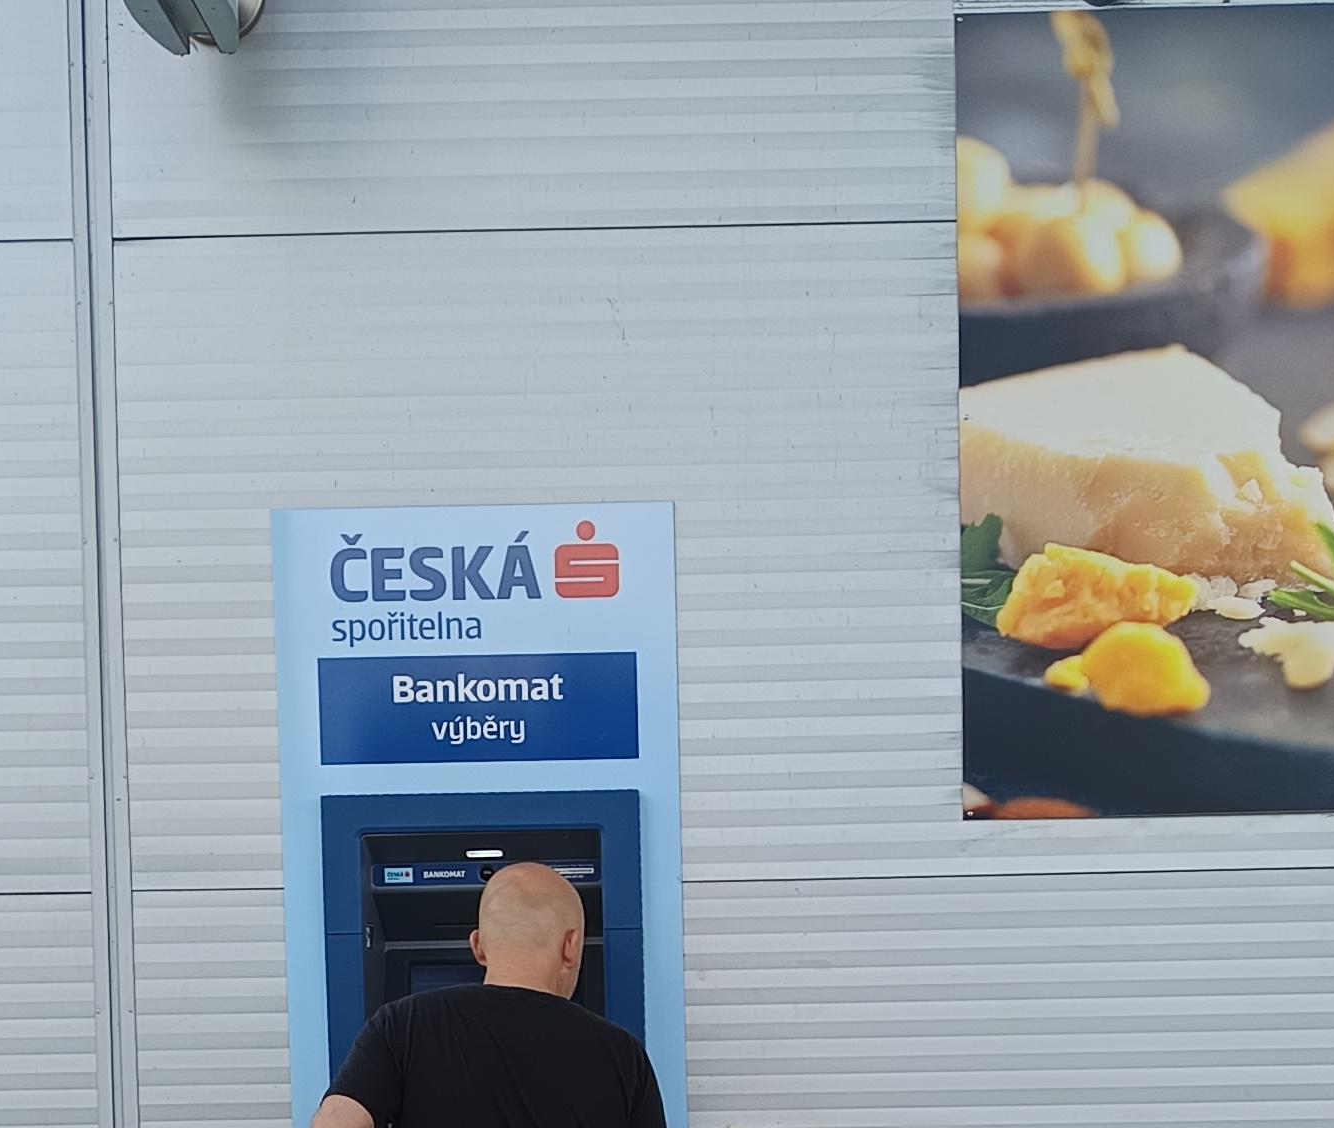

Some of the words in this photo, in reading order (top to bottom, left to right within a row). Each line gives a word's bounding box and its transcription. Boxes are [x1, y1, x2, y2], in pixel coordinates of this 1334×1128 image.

[330, 531, 542, 602] ČESKÁ
[331, 610, 482, 647] spořitelna
[392, 673, 564, 704] Bankomat
[431, 715, 526, 745] výběry
[423, 870, 466, 879] BANKOMAT
